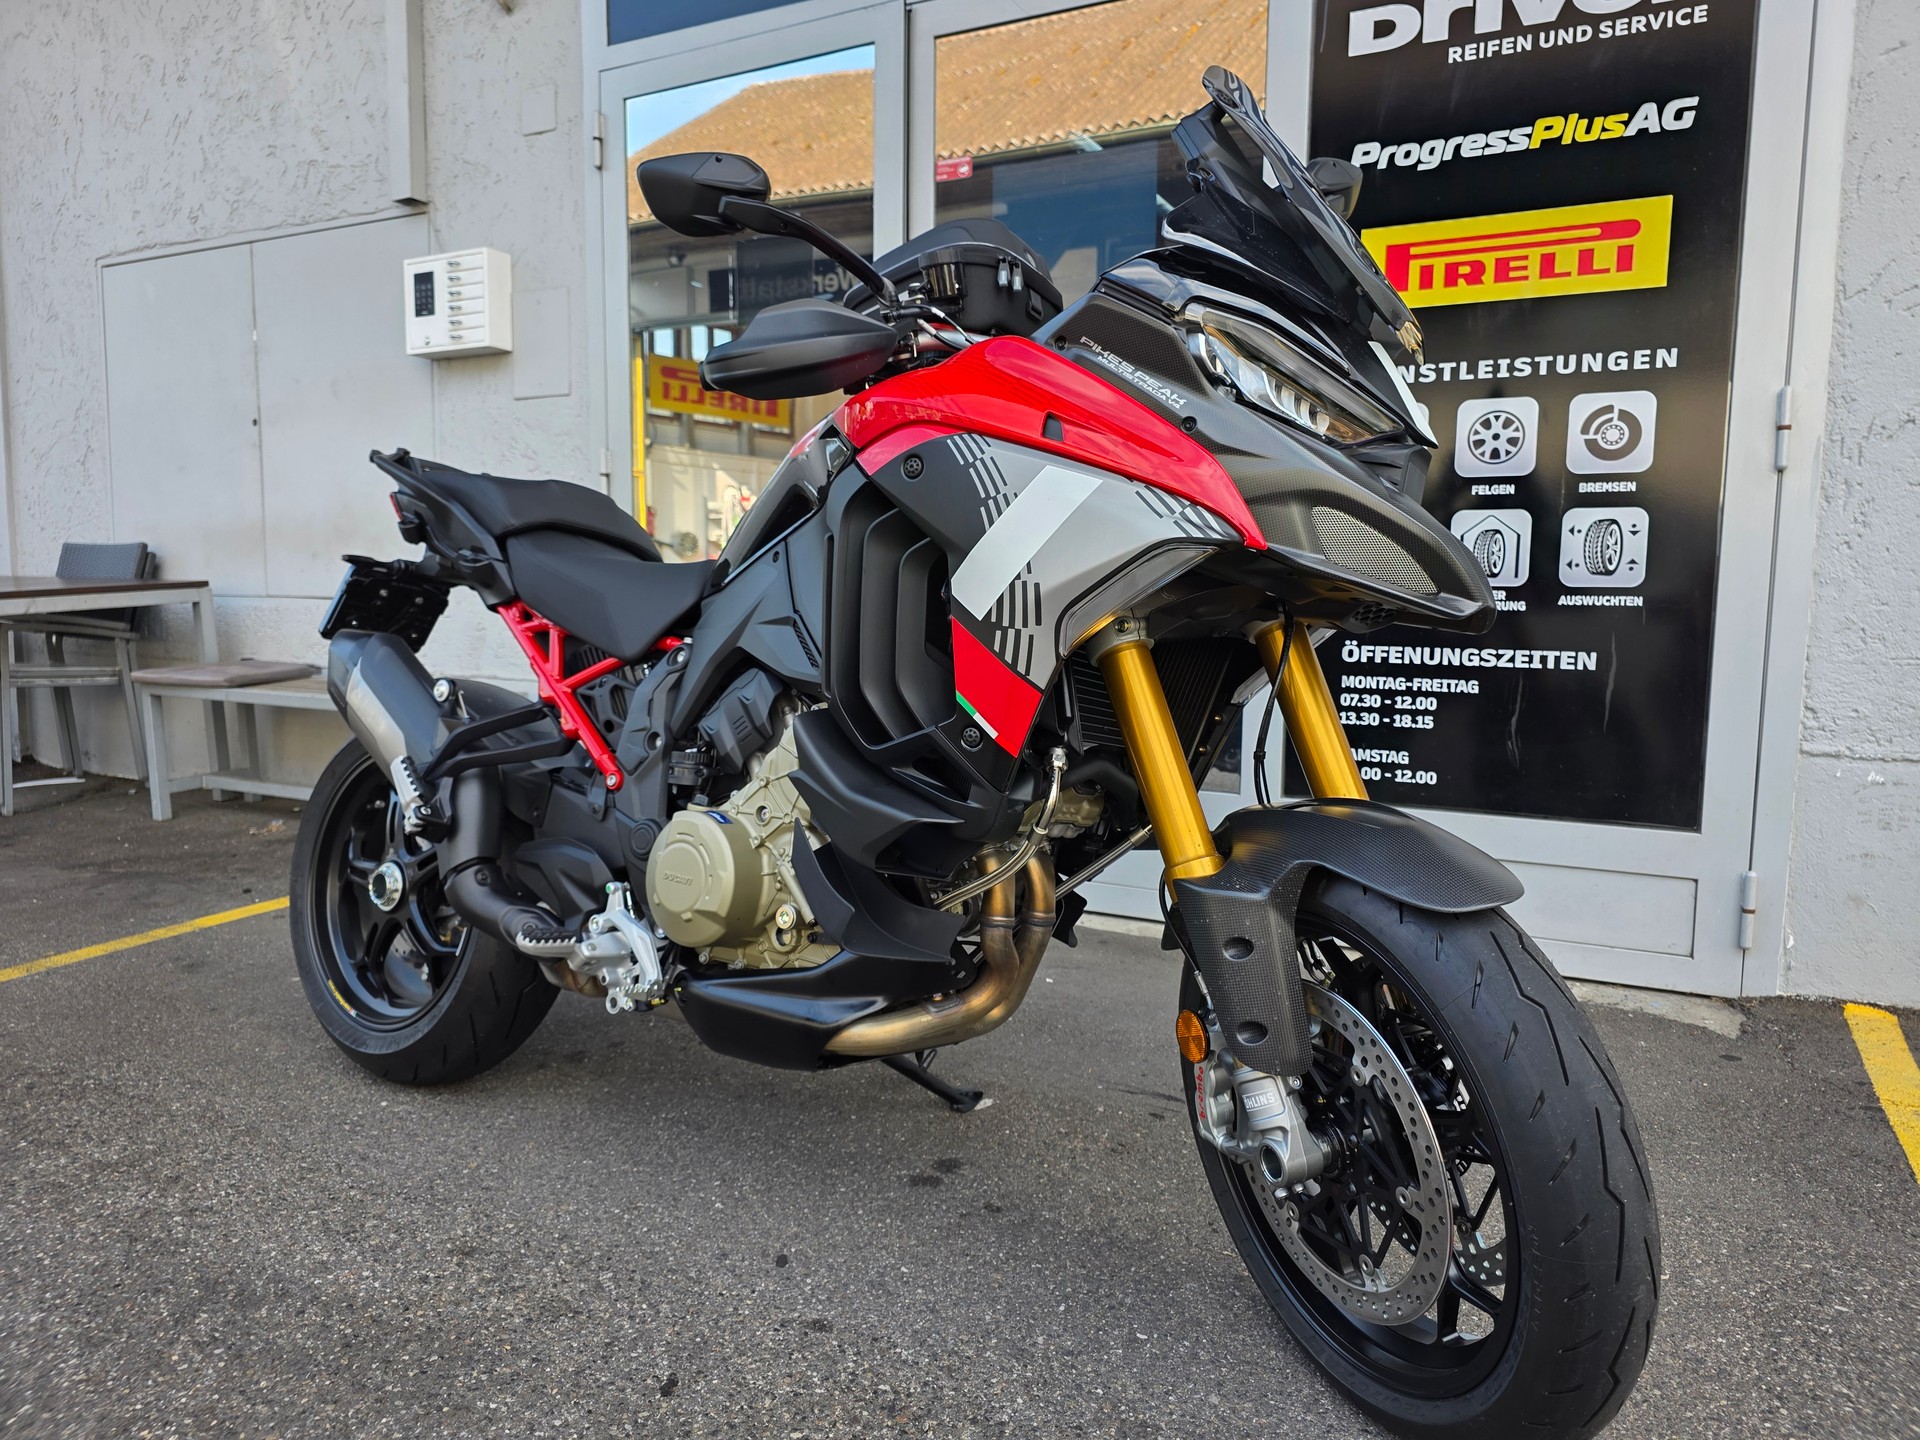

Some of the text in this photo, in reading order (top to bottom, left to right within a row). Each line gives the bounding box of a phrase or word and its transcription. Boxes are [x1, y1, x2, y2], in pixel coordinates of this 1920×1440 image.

[1348, 0, 1676, 57] Driv
[1448, 4, 1708, 63] REIFEN UND SERVICE
[1350, 96, 1700, 171] ProgressPlusAG
[1385, 219, 1641, 292] PIRELLI
[1080, 336, 1187, 406] PIKES PEAK
[1396, 347, 1679, 384] NSTLEISTUNGEN
[1097, 355, 1181, 410] MULTISTRADA V4
[1471, 484, 1515, 496] FELGEN
[1578, 481, 1637, 493] BREMSEN
[1492, 590, 1506, 601] ER
[1557, 595, 1643, 607] AUSWUCHTEN
[1495, 600, 1526, 611] RUNG
[1341, 640, 1598, 671] ÖFFENUNGSZEITEN
[1341, 675, 1479, 694] MONTAG-FREITAG
[1340, 693, 1382, 708] 07.30
[1394, 696, 1438, 711] 12.00
[1339, 711, 1380, 726] 13.30
[1392, 714, 1434, 729] 18.15
[1350, 747, 1409, 765] AMSTAG
[1394, 769, 1438, 785] 12.00
[1196, 1066, 1206, 1120] brembo
